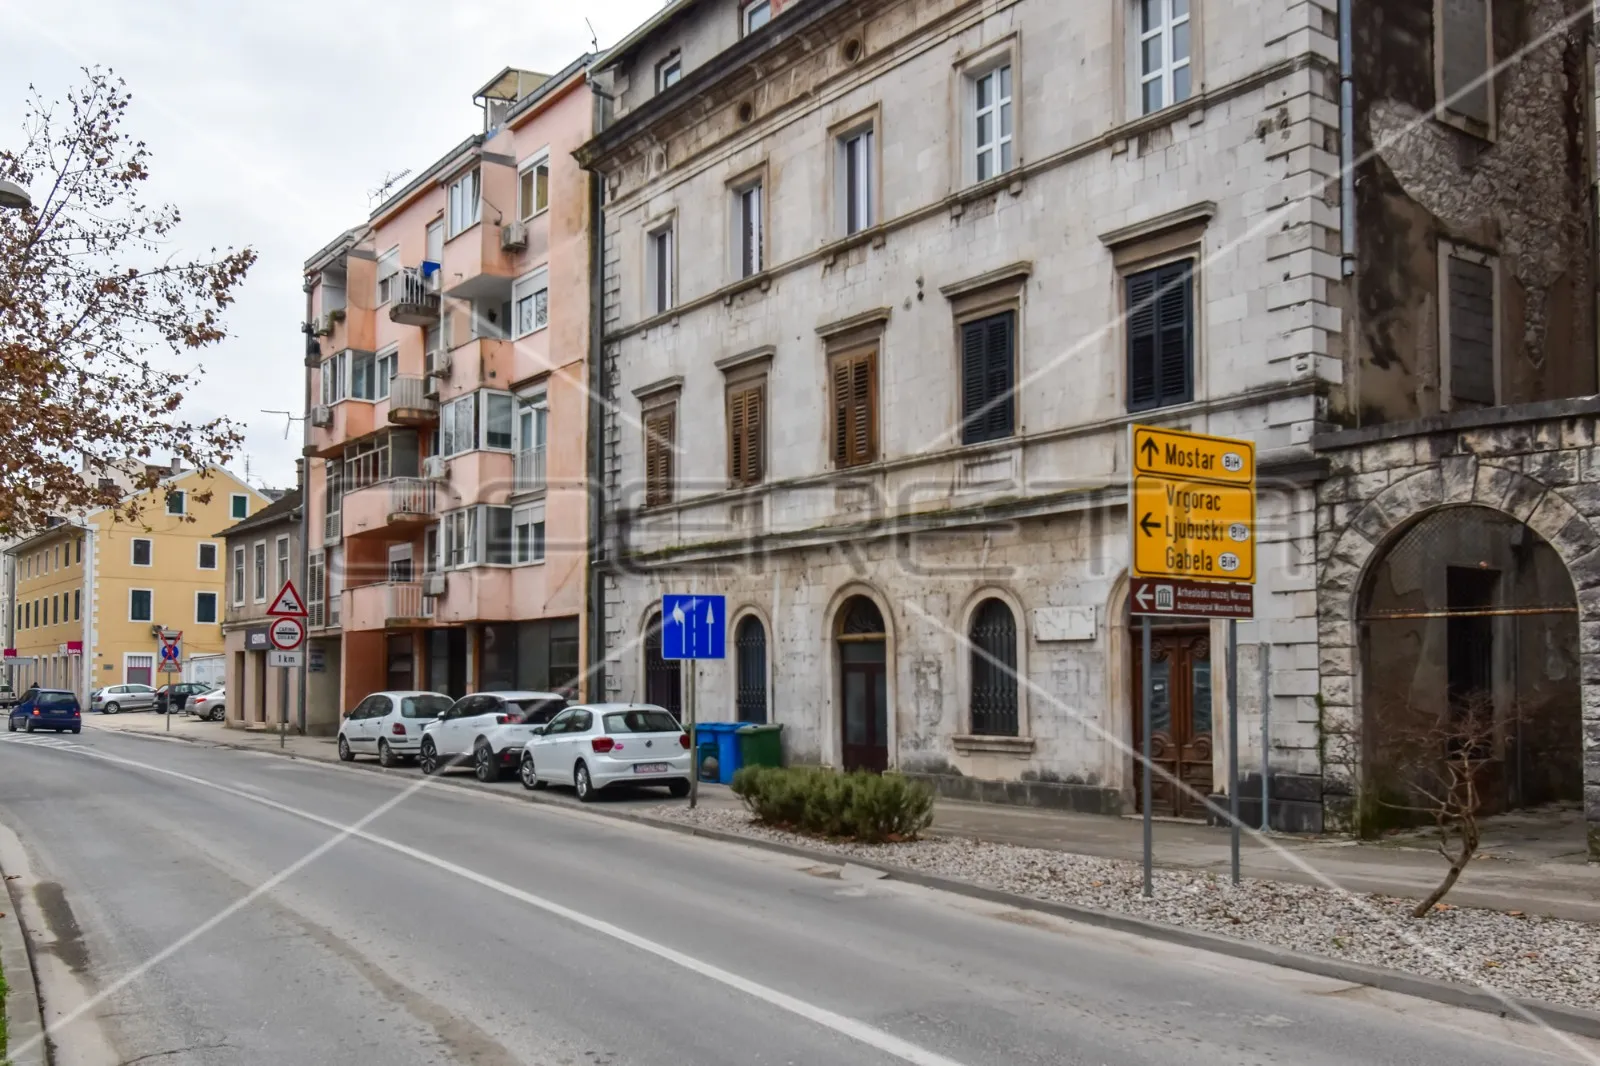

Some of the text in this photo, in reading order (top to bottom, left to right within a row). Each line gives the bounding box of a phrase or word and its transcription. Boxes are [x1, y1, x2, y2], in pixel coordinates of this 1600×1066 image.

[1165, 443, 1215, 470] Mostar
[1166, 484, 1221, 513] Vrgorac
[1165, 514, 1224, 544] Ljubuški
[1165, 548, 1213, 572] Gabela
[283, 655, 295, 663] km
